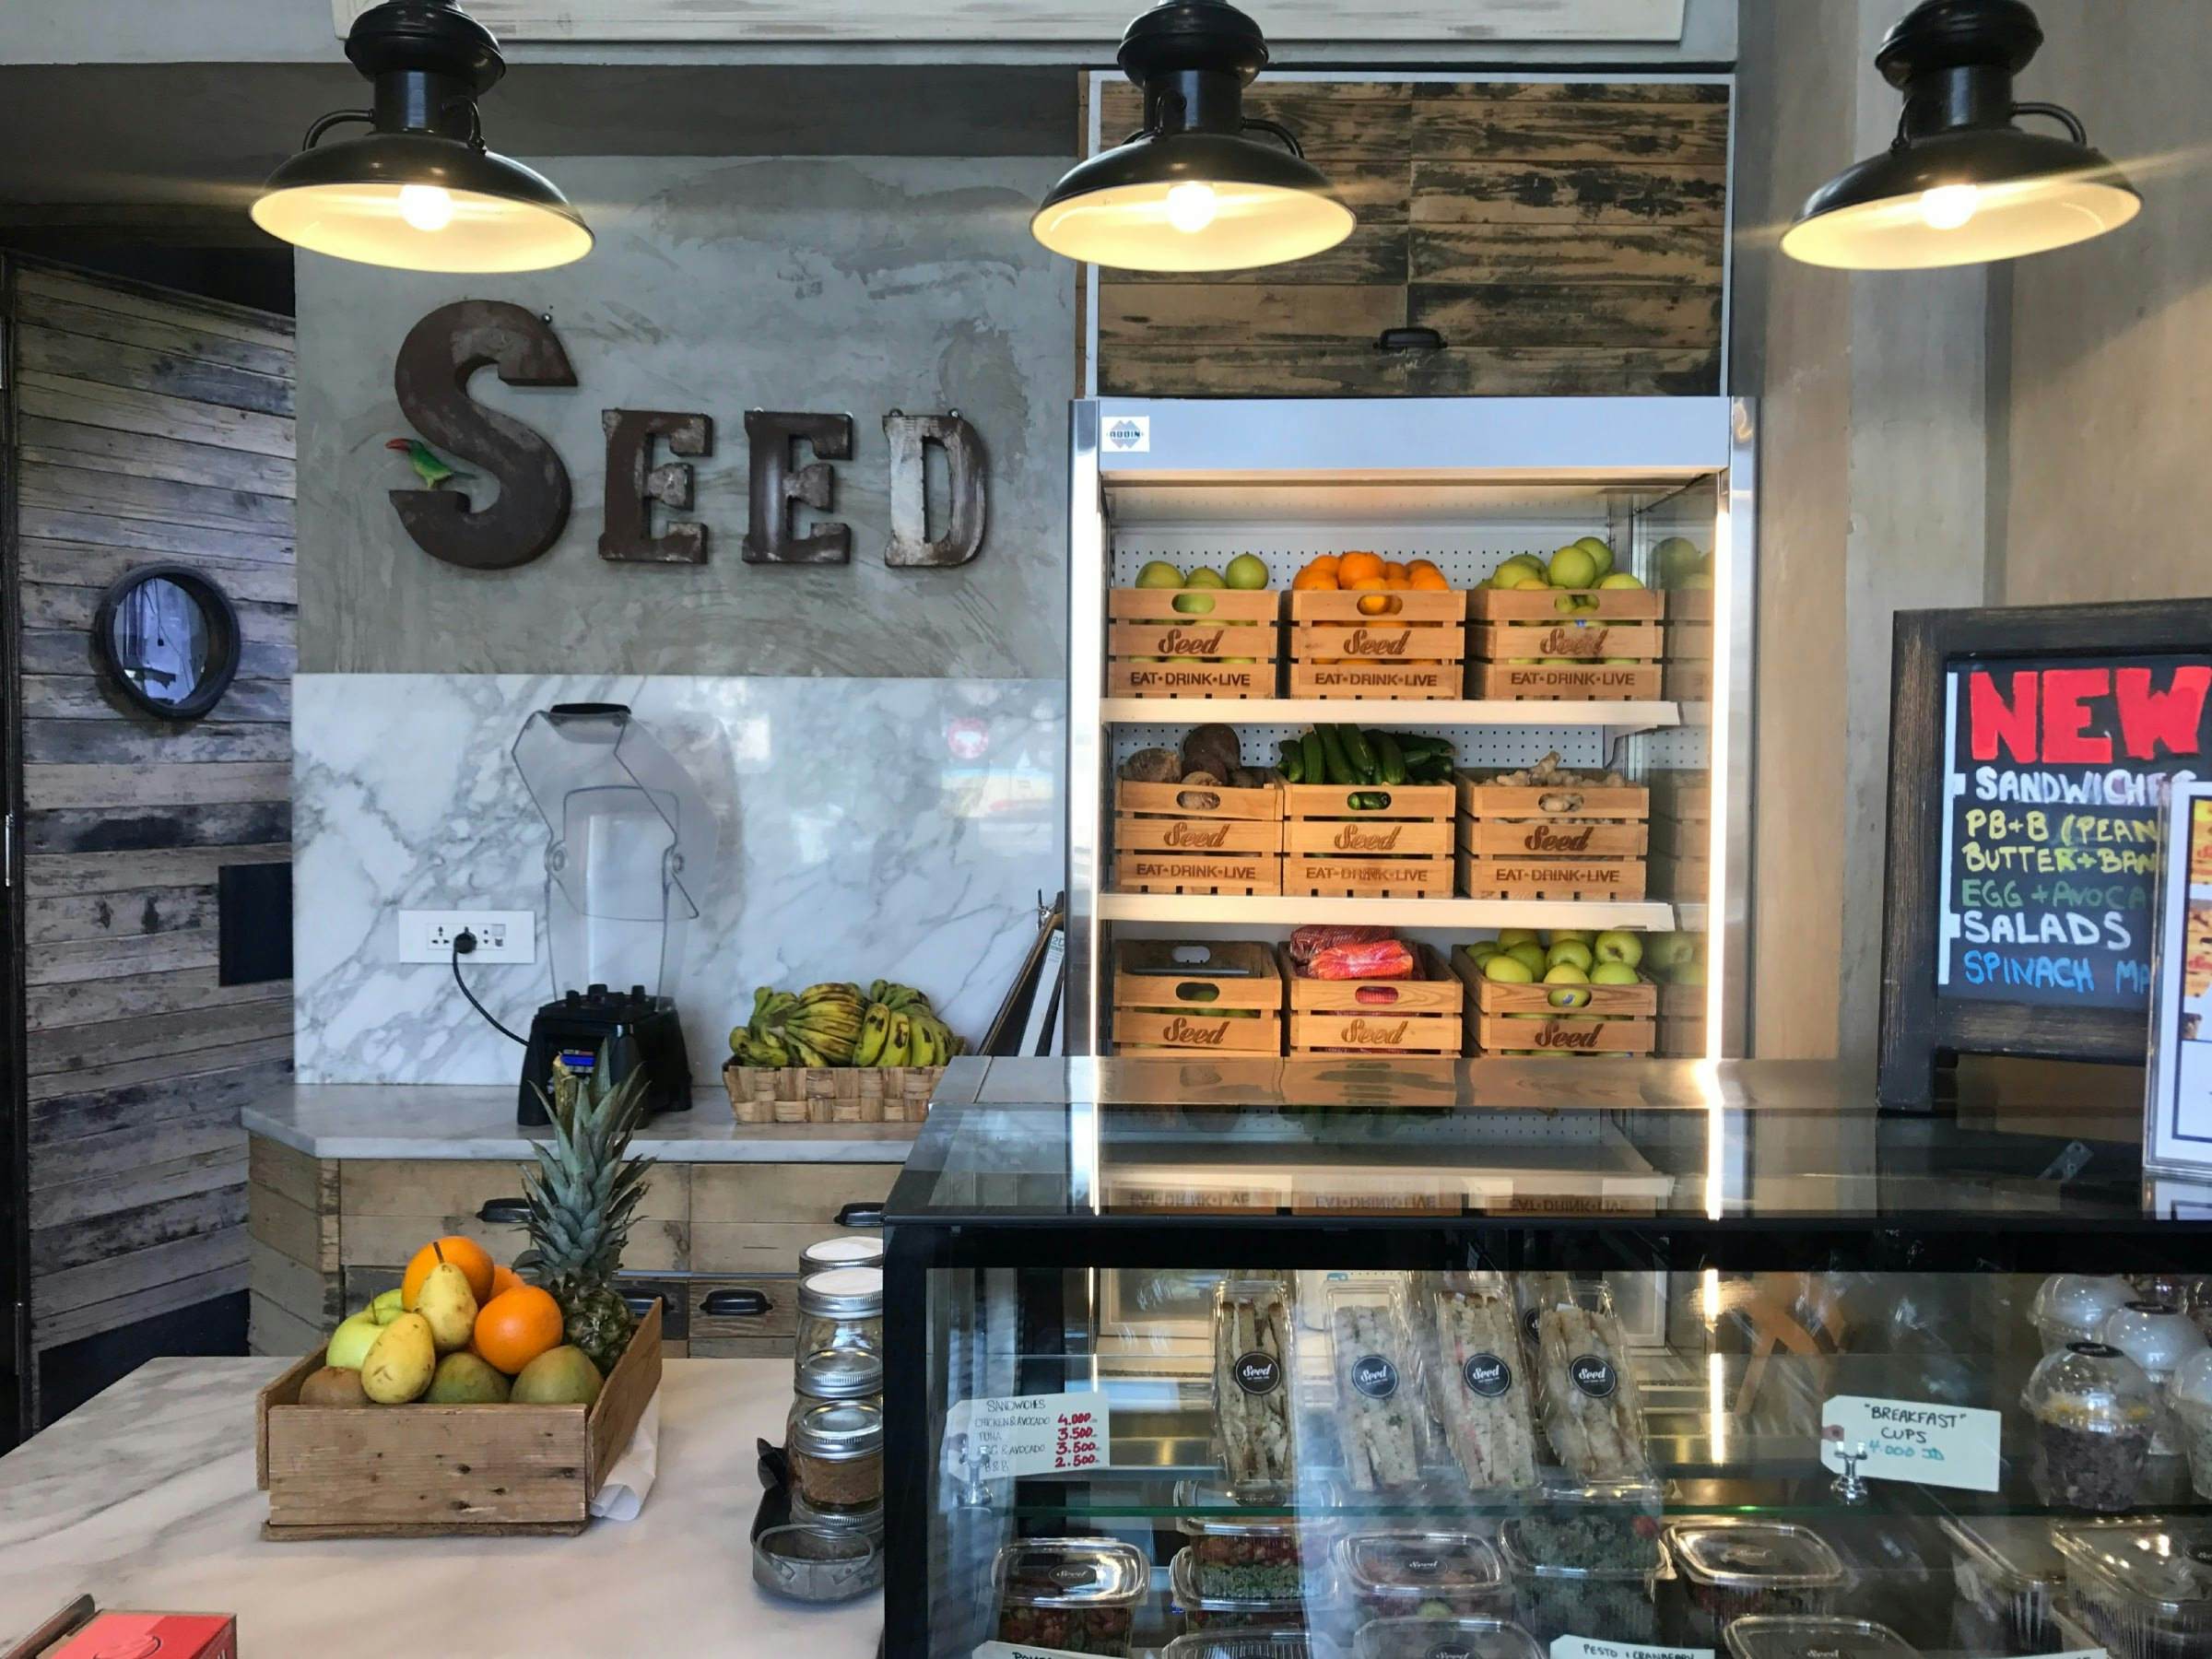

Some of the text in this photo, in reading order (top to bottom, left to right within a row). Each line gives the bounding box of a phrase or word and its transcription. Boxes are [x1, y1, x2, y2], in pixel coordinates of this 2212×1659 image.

[1158, 629, 1224, 654] Seed
[1343, 629, 1411, 655] Seed
[1970, 665, 2212, 764] NEW
[1163, 821, 1230, 848] Seed
[1334, 823, 1403, 851] Seed
[1524, 825, 1594, 852] Seed
[1961, 878, 2024, 909] EGG
[1963, 910, 2132, 951] SALADS
[1963, 949, 2095, 993] SPINACH
[1163, 1018, 1230, 1044] Seed
[1341, 1018, 1408, 1044] Seed
[1535, 1019, 1605, 1048] Seed
[1243, 1364, 1272, 1377] Seed
[1360, 1365, 1387, 1382] Seed
[1473, 1364, 1500, 1380] Seed
[1578, 1366, 1606, 1380] Seed
[1881, 1427, 1927, 1444] CUPS
[1583, 1643, 1618, 1658] PESTO
